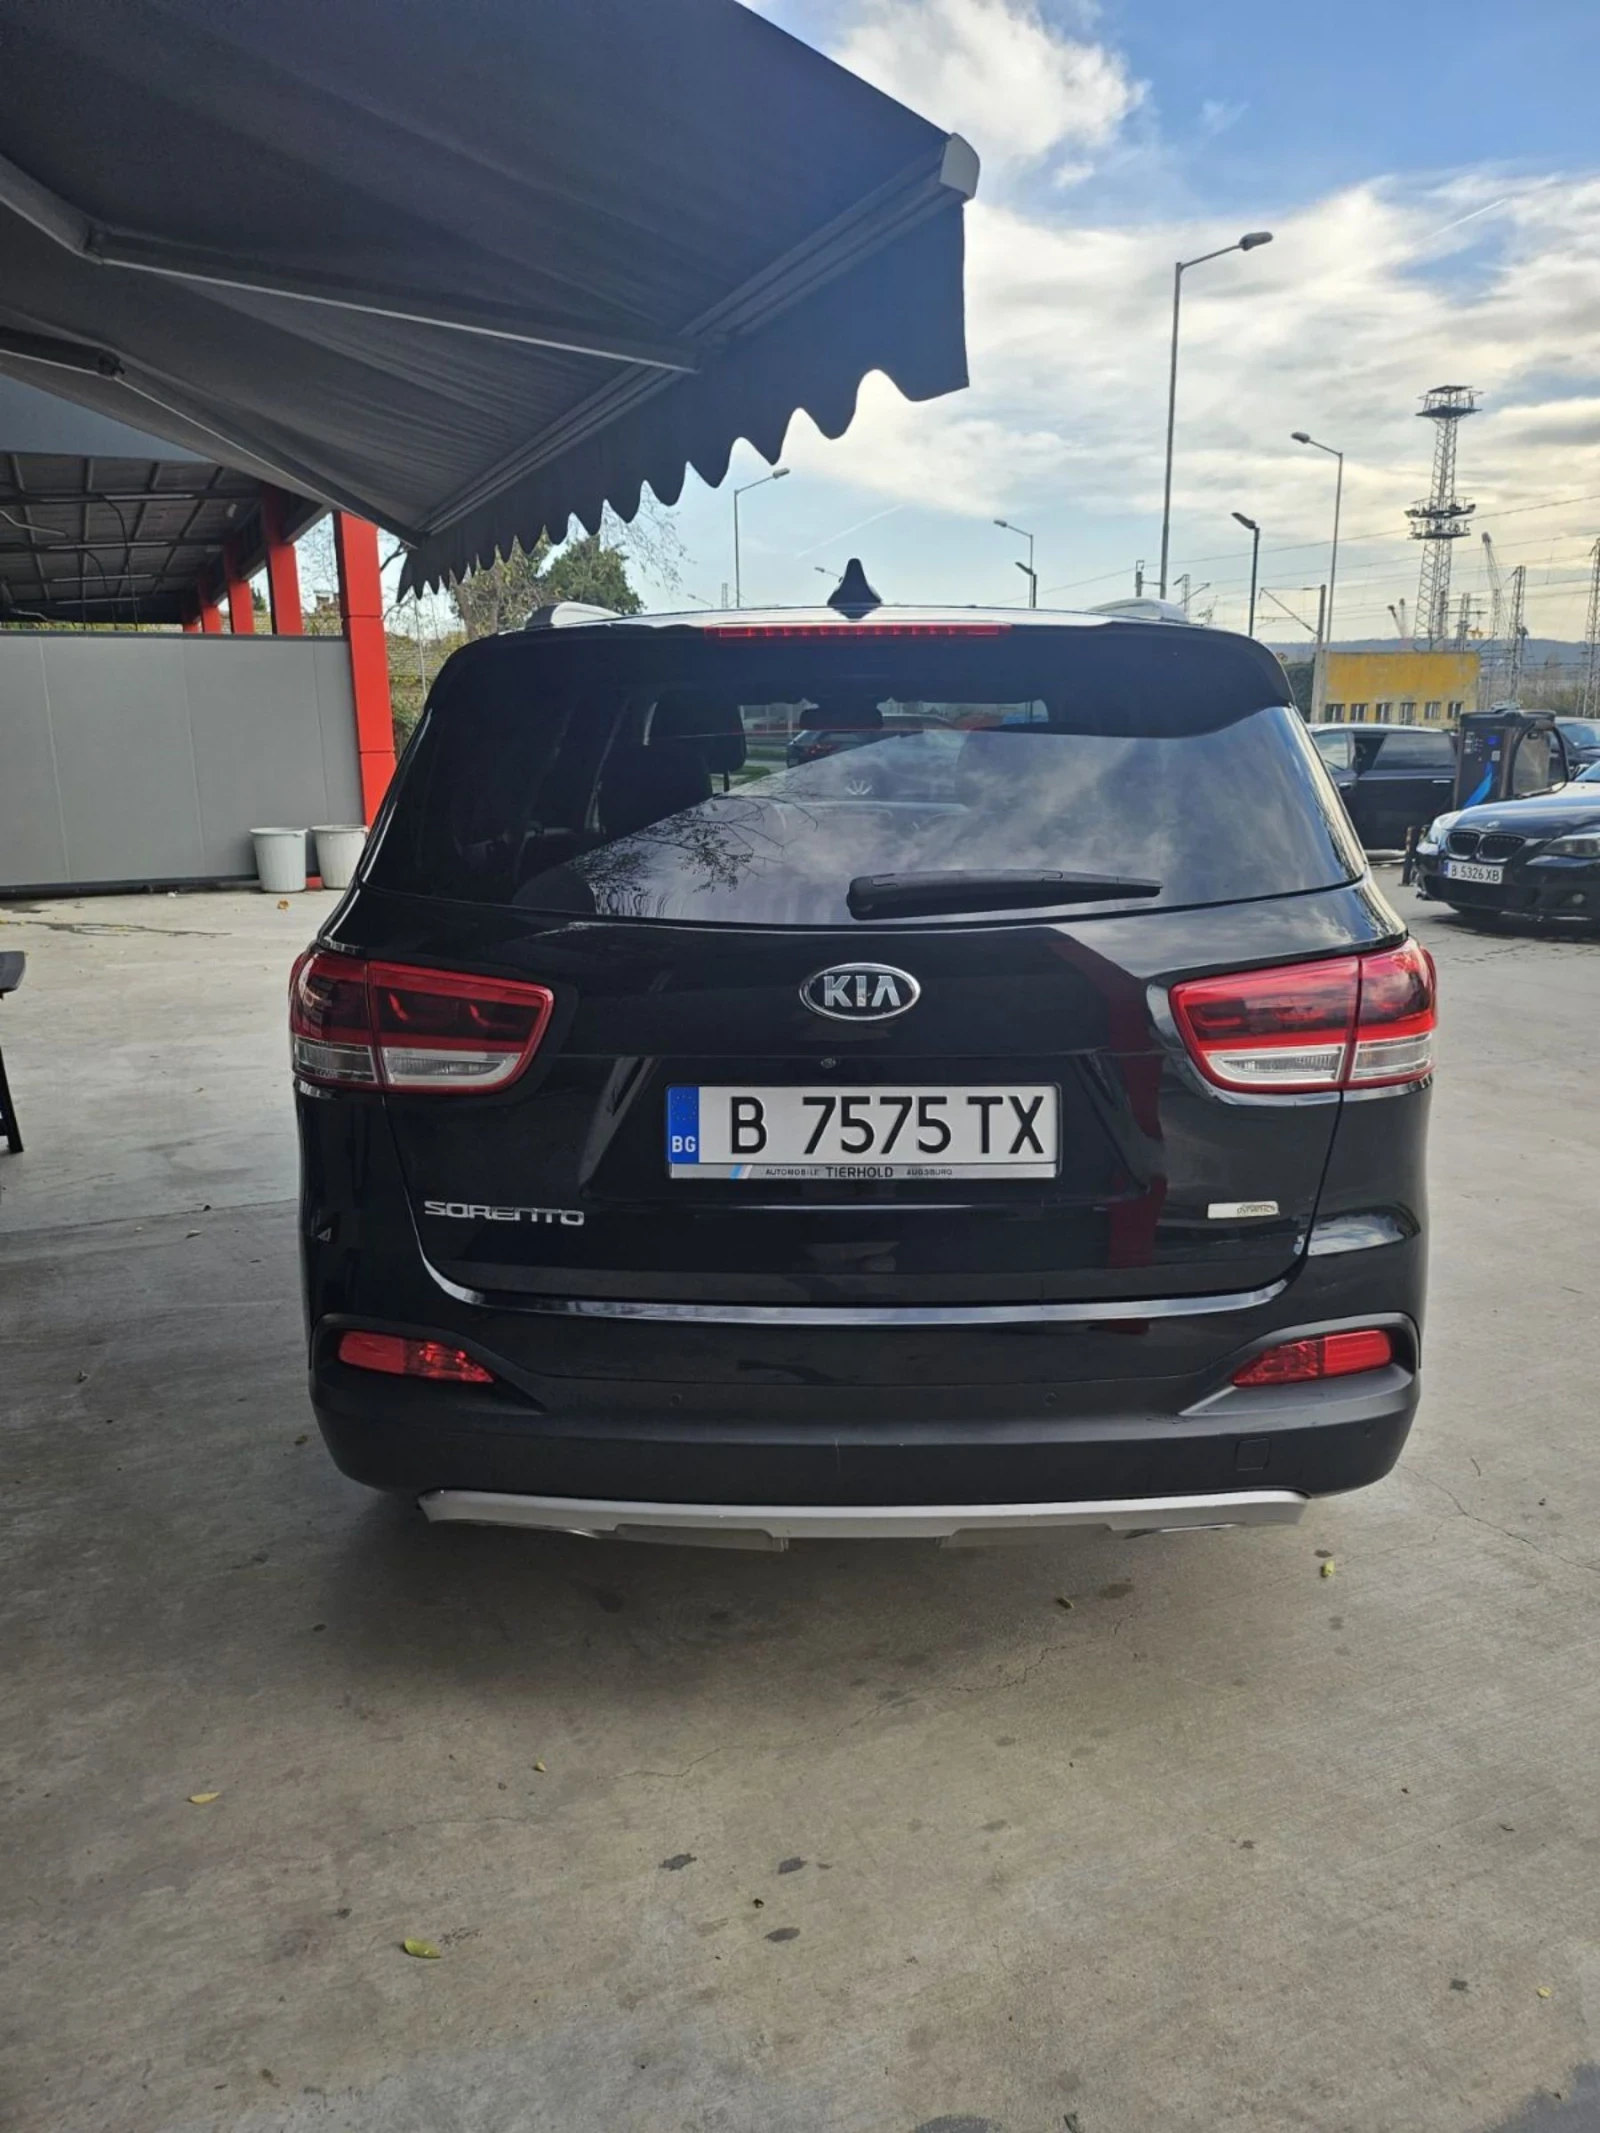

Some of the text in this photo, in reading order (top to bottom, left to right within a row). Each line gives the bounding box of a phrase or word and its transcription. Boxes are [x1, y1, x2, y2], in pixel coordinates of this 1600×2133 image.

[1451, 864, 1457, 877] B
[1461, 865, 1484, 880] 5326
[823, 975, 901, 1007] KIA
[730, 1096, 1045, 1155] B 7575 TX
[671, 1135, 697, 1153] BG
[825, 1166, 894, 1179] TIERHOLD
[424, 1201, 585, 1226] SORENTO
